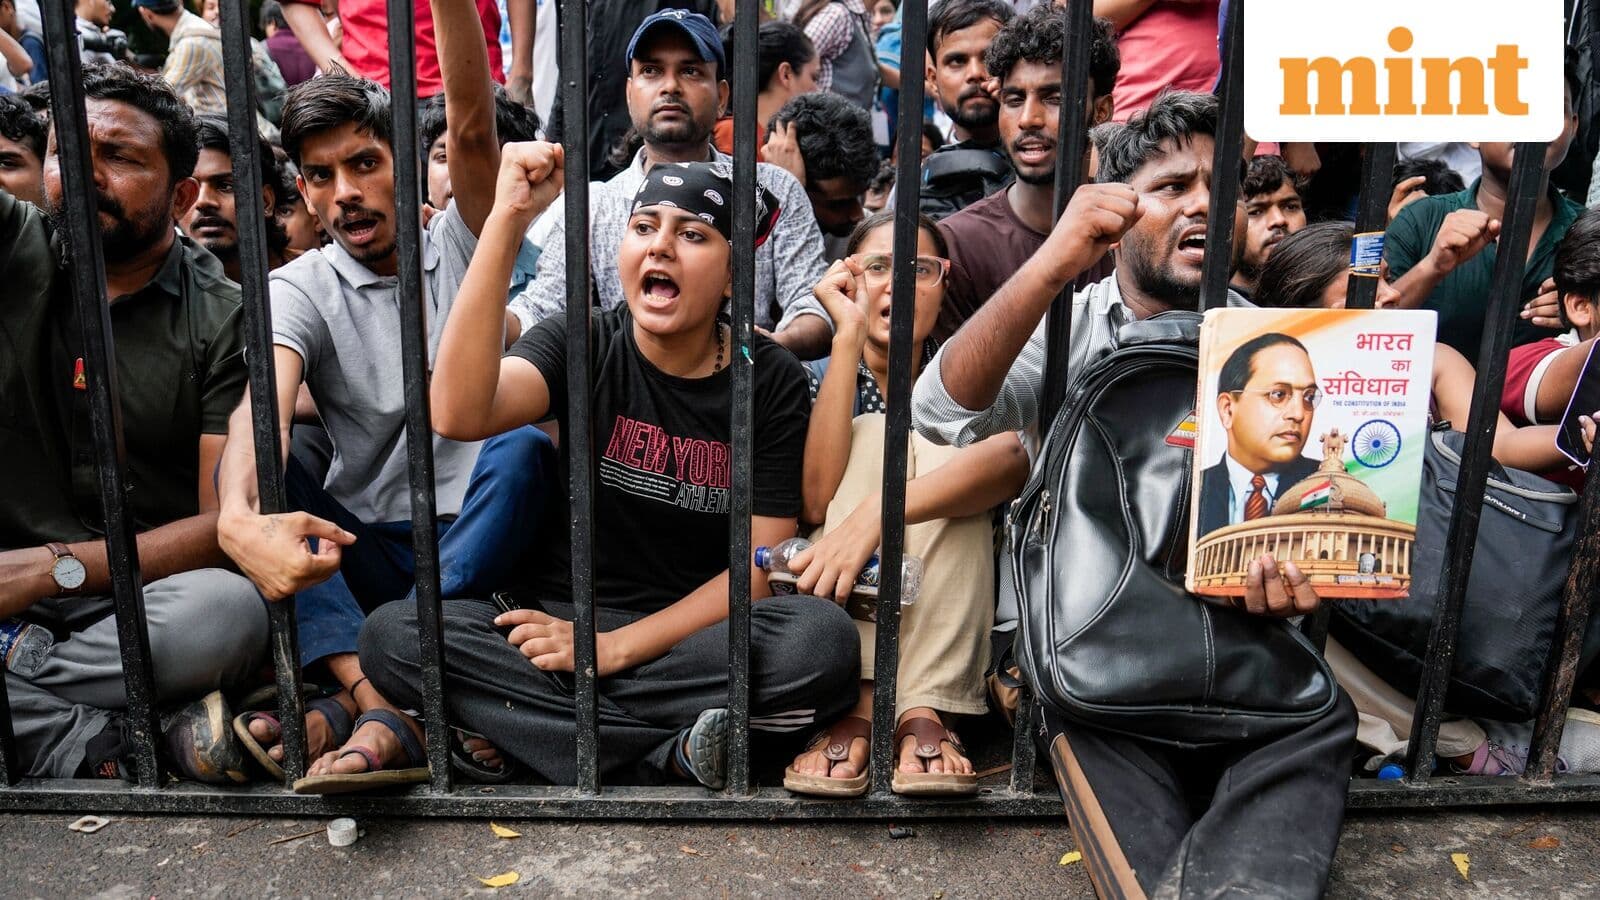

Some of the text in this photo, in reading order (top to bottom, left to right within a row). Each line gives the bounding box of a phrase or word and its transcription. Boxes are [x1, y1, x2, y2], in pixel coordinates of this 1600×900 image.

[1356, 333, 1414, 351] भारत
[1391, 360, 1412, 372] का
[1322, 370, 1410, 396] संविधान
[605, 415, 670, 474] NEW
[672, 436, 732, 488] YOR
